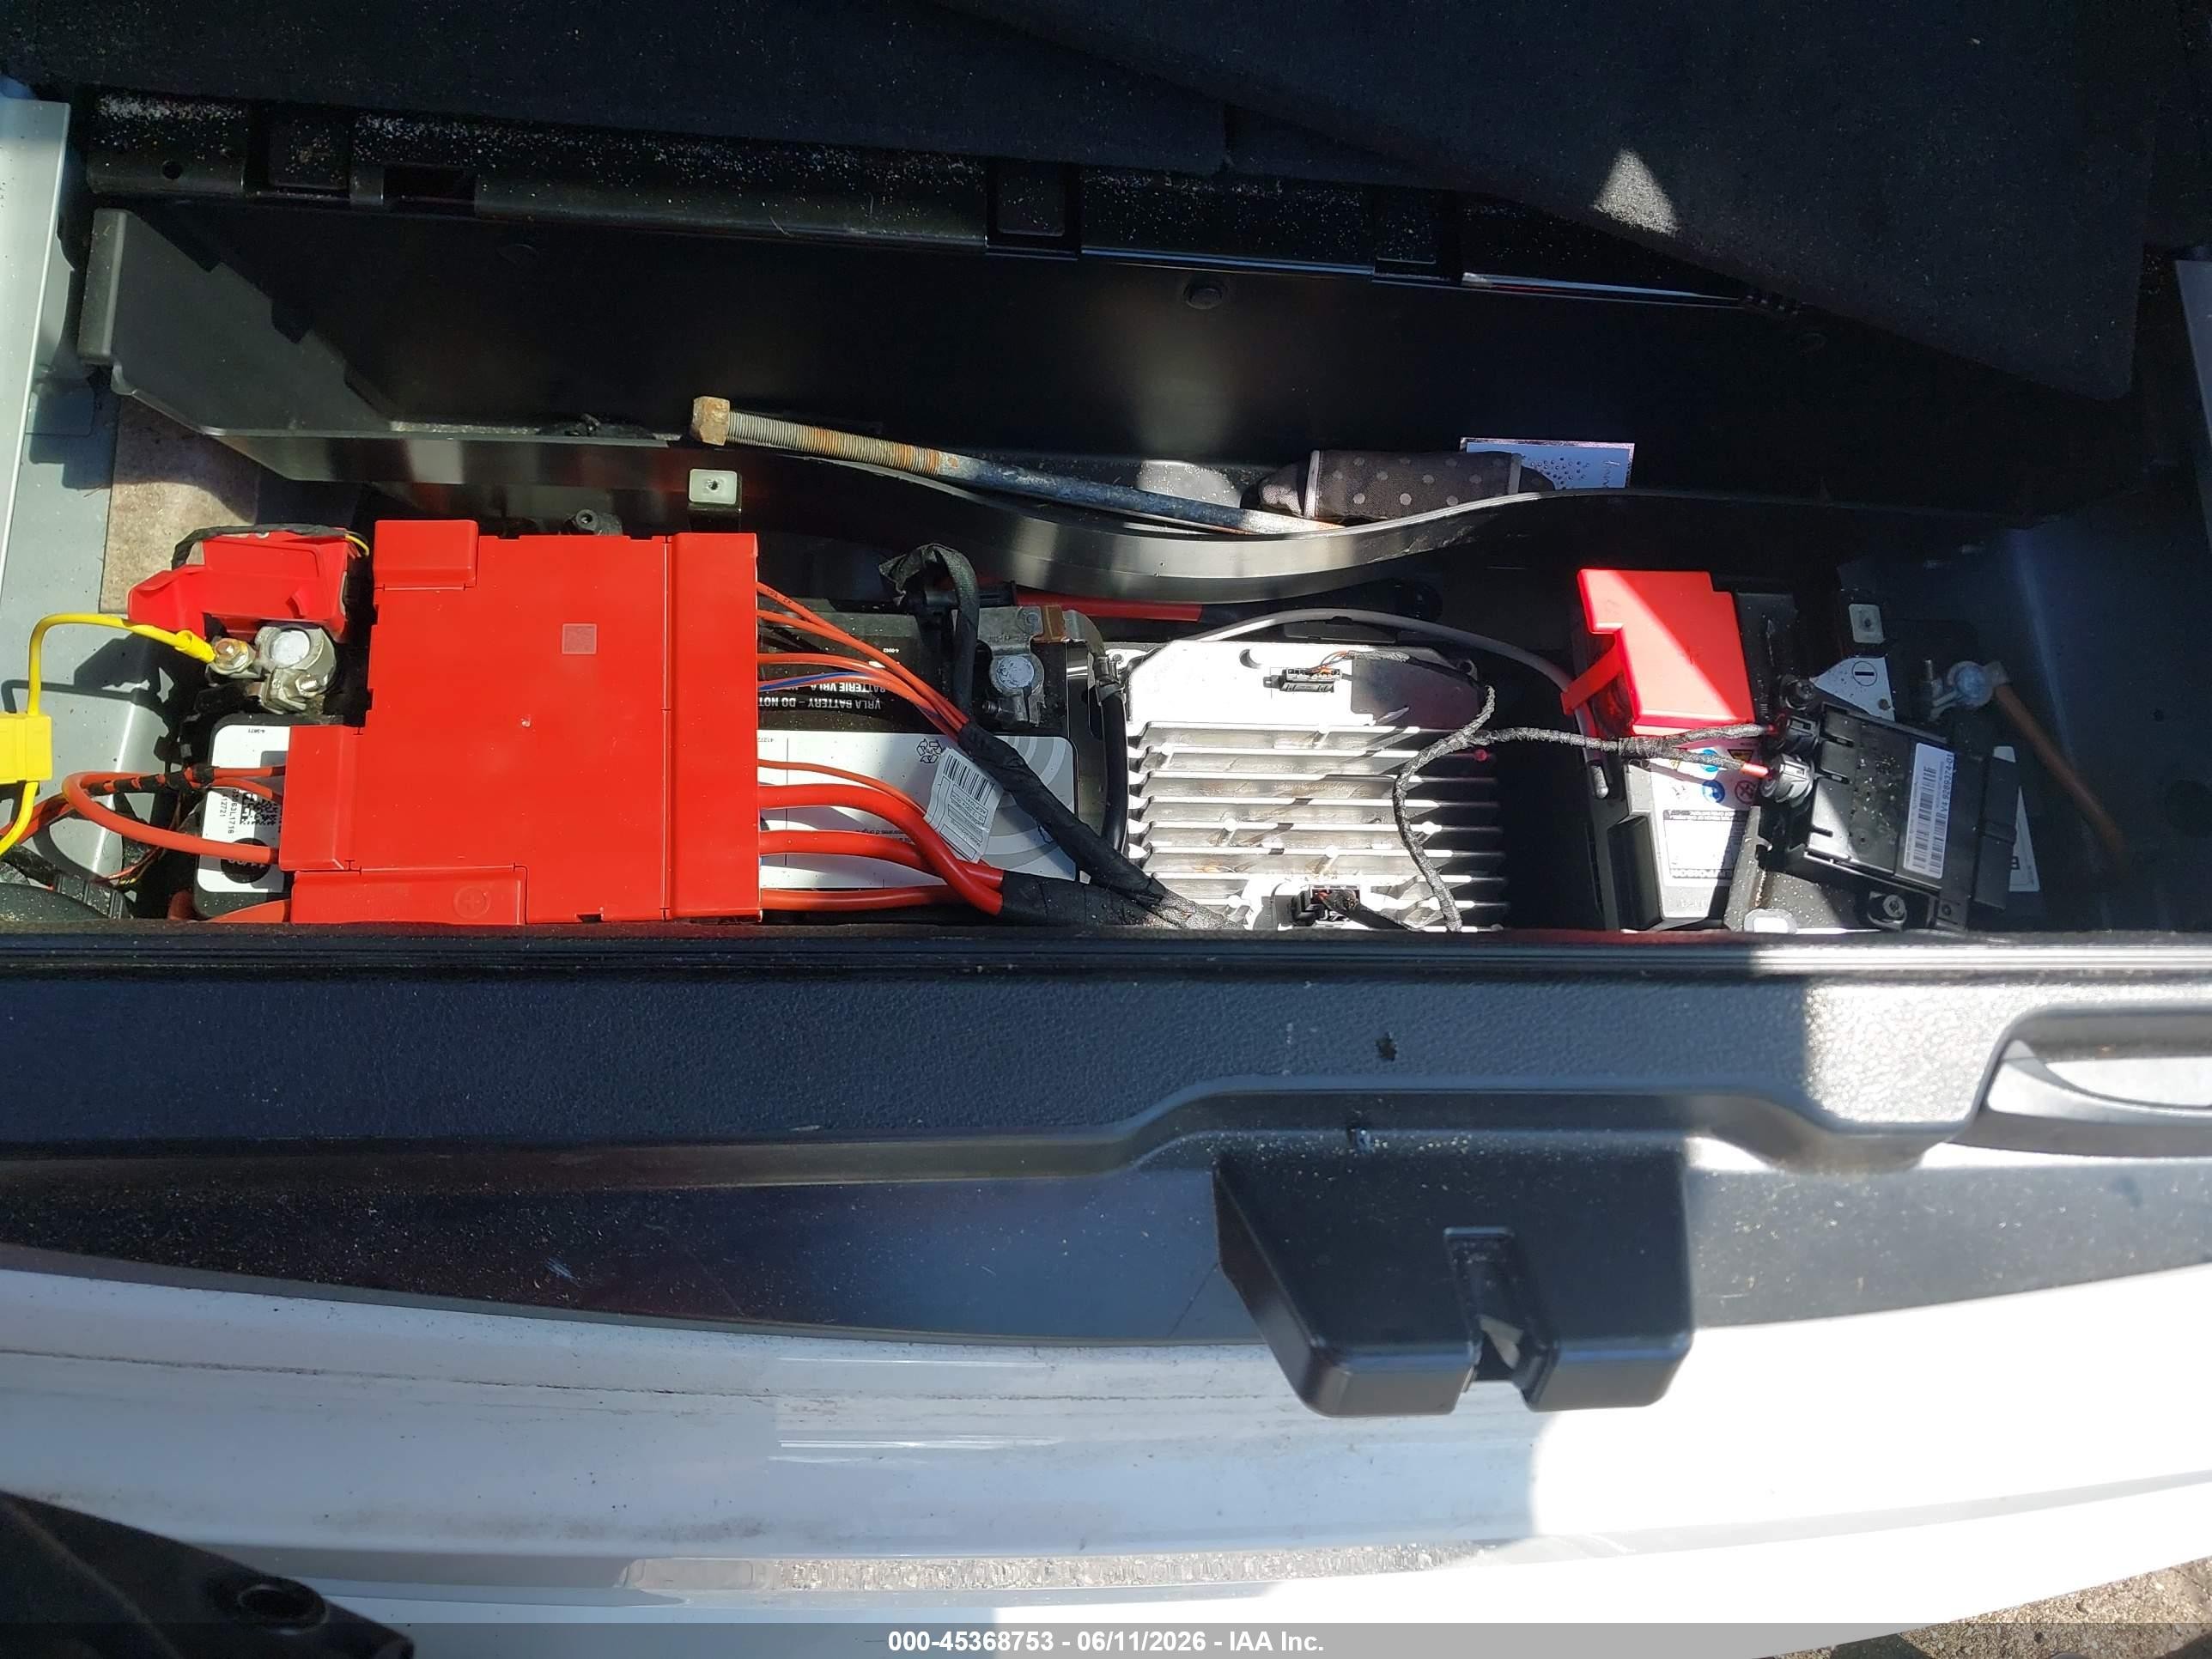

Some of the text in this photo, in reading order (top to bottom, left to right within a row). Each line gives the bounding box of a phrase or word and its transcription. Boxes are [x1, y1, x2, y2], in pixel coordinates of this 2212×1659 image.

[781, 696, 797, 708] DO
[808, 696, 853, 709] BATTERY
[855, 697, 881, 710] VRLA
